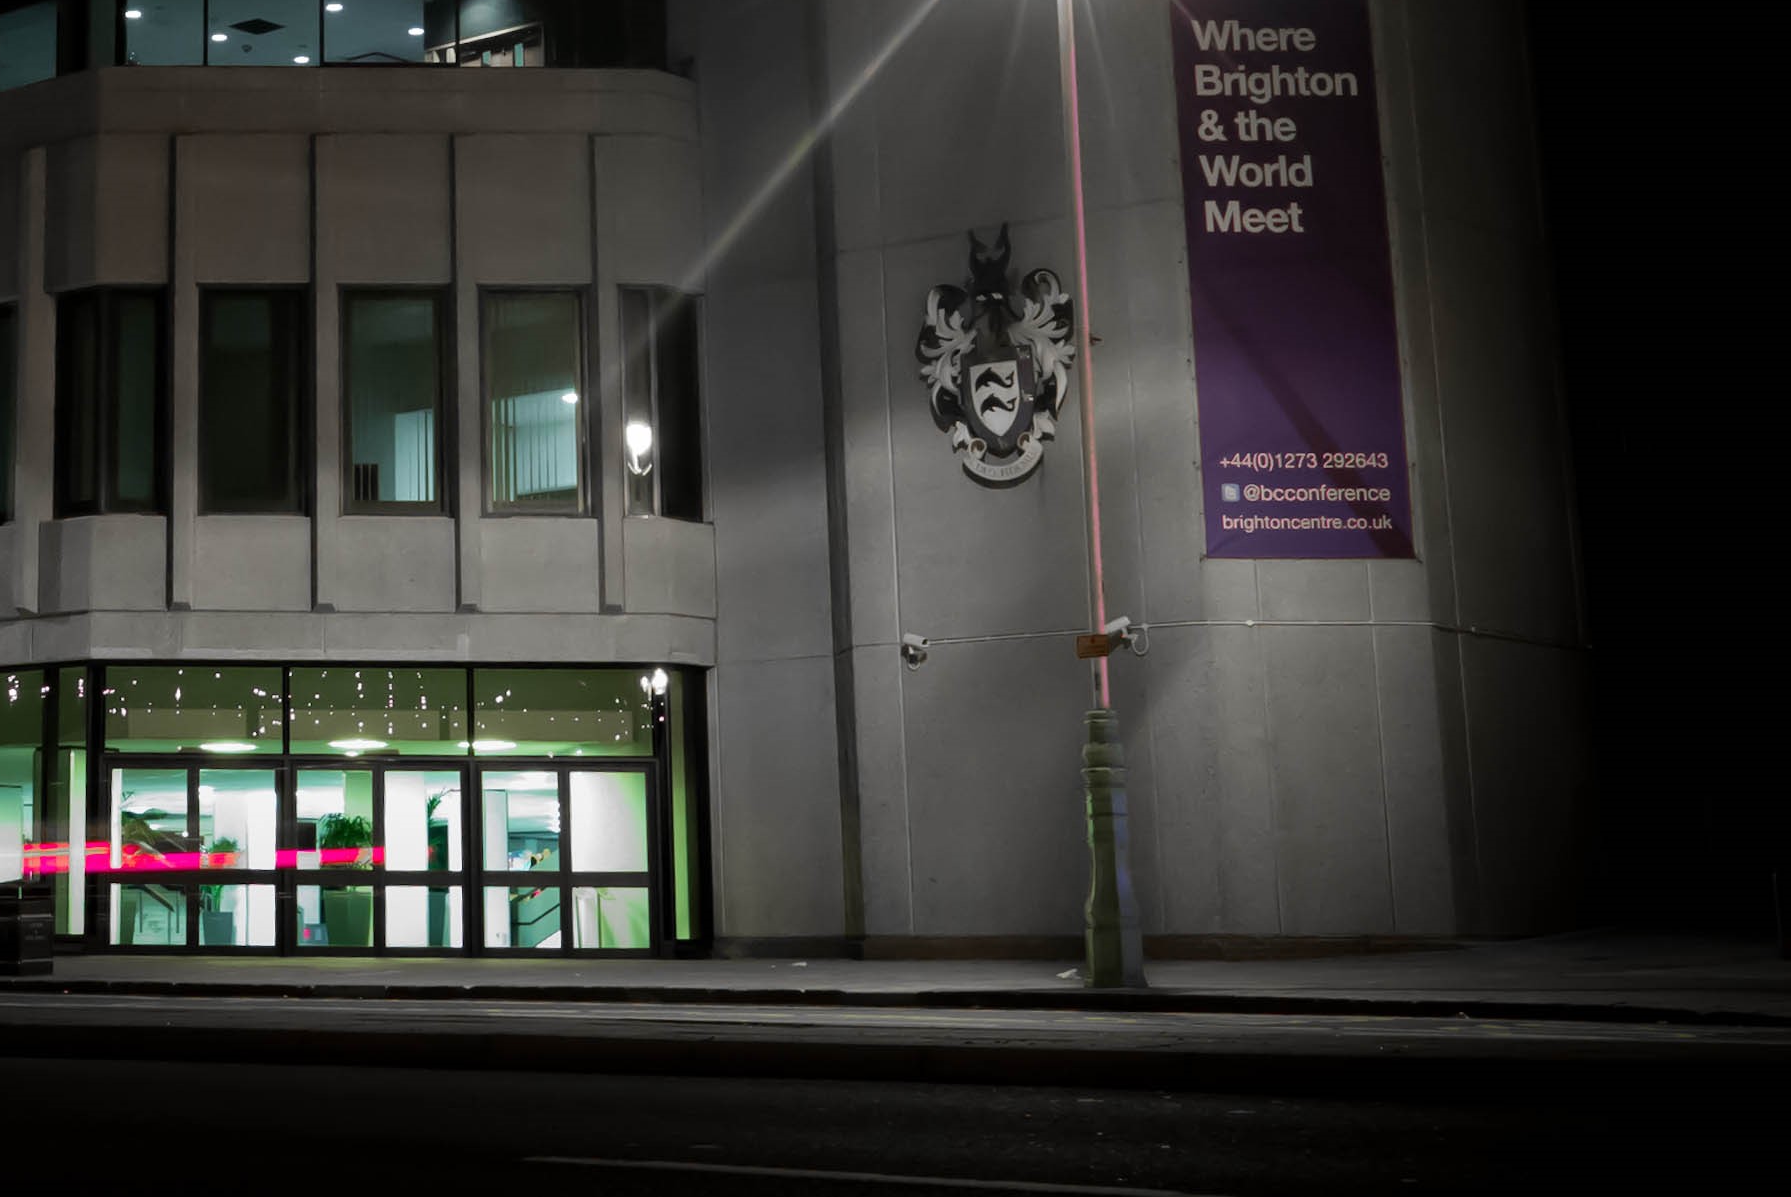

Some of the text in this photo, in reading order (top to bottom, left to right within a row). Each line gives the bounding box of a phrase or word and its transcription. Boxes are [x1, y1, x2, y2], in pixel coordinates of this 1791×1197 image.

[1192, 20, 1316, 51] Where
[1194, 65, 1358, 103] Brighton
[1197, 109, 1297, 142] & the
[1199, 155, 1313, 187] World
[1203, 201, 1304, 233] Meet
[1219, 452, 1389, 472] +44(0)1273 292643
[1243, 484, 1391, 501] @bcconference
[1222, 515, 1393, 533] brightoncentre.co.uk
